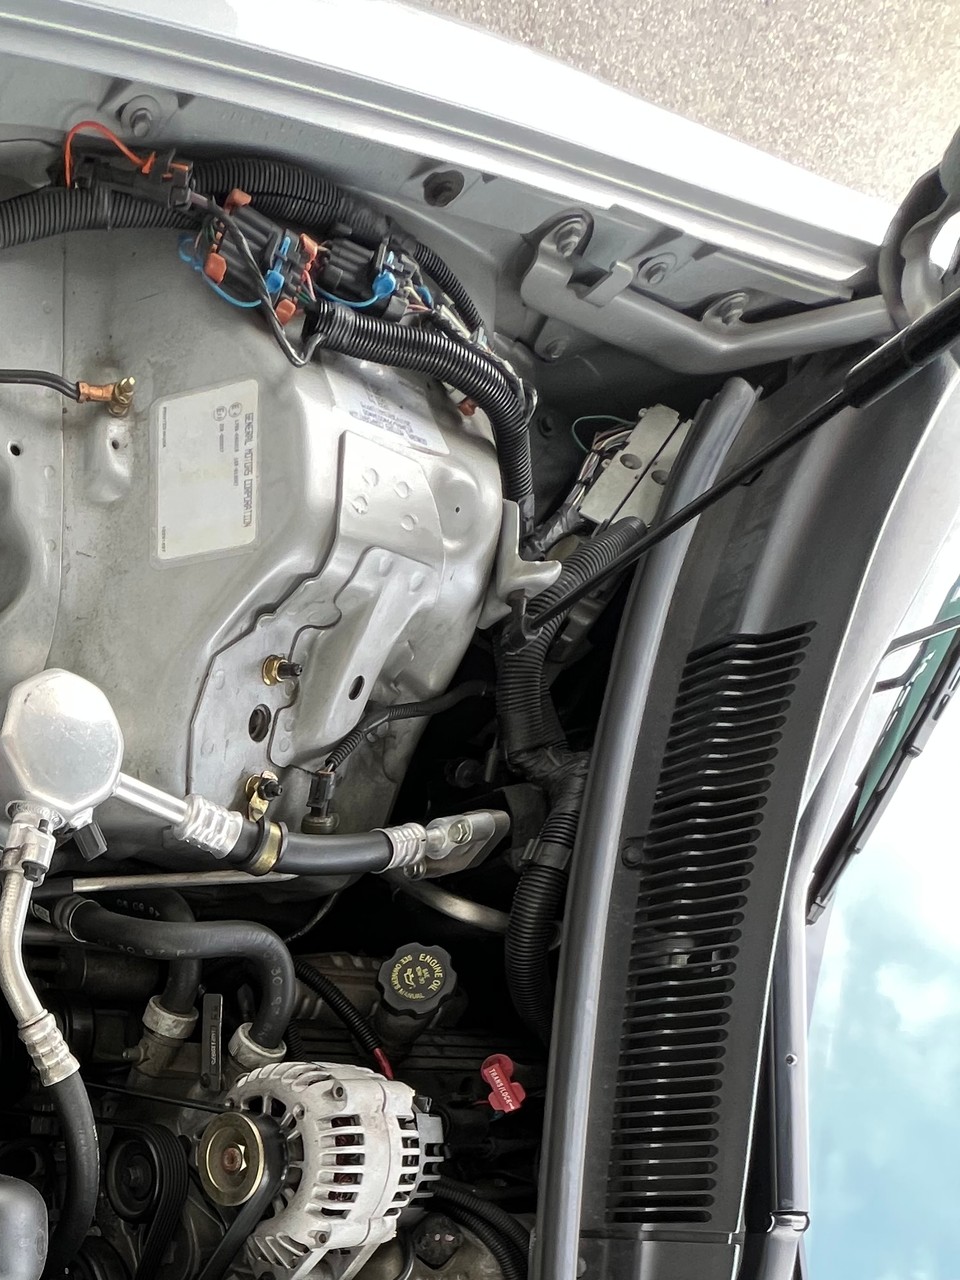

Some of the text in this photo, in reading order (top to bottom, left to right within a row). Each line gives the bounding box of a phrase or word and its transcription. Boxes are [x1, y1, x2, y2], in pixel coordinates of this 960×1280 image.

[242, 413, 254, 528] GENERAL MOTORS CORPORATION
[419, 954, 443, 978] ENGINE
[428, 980, 440, 992] OIL
